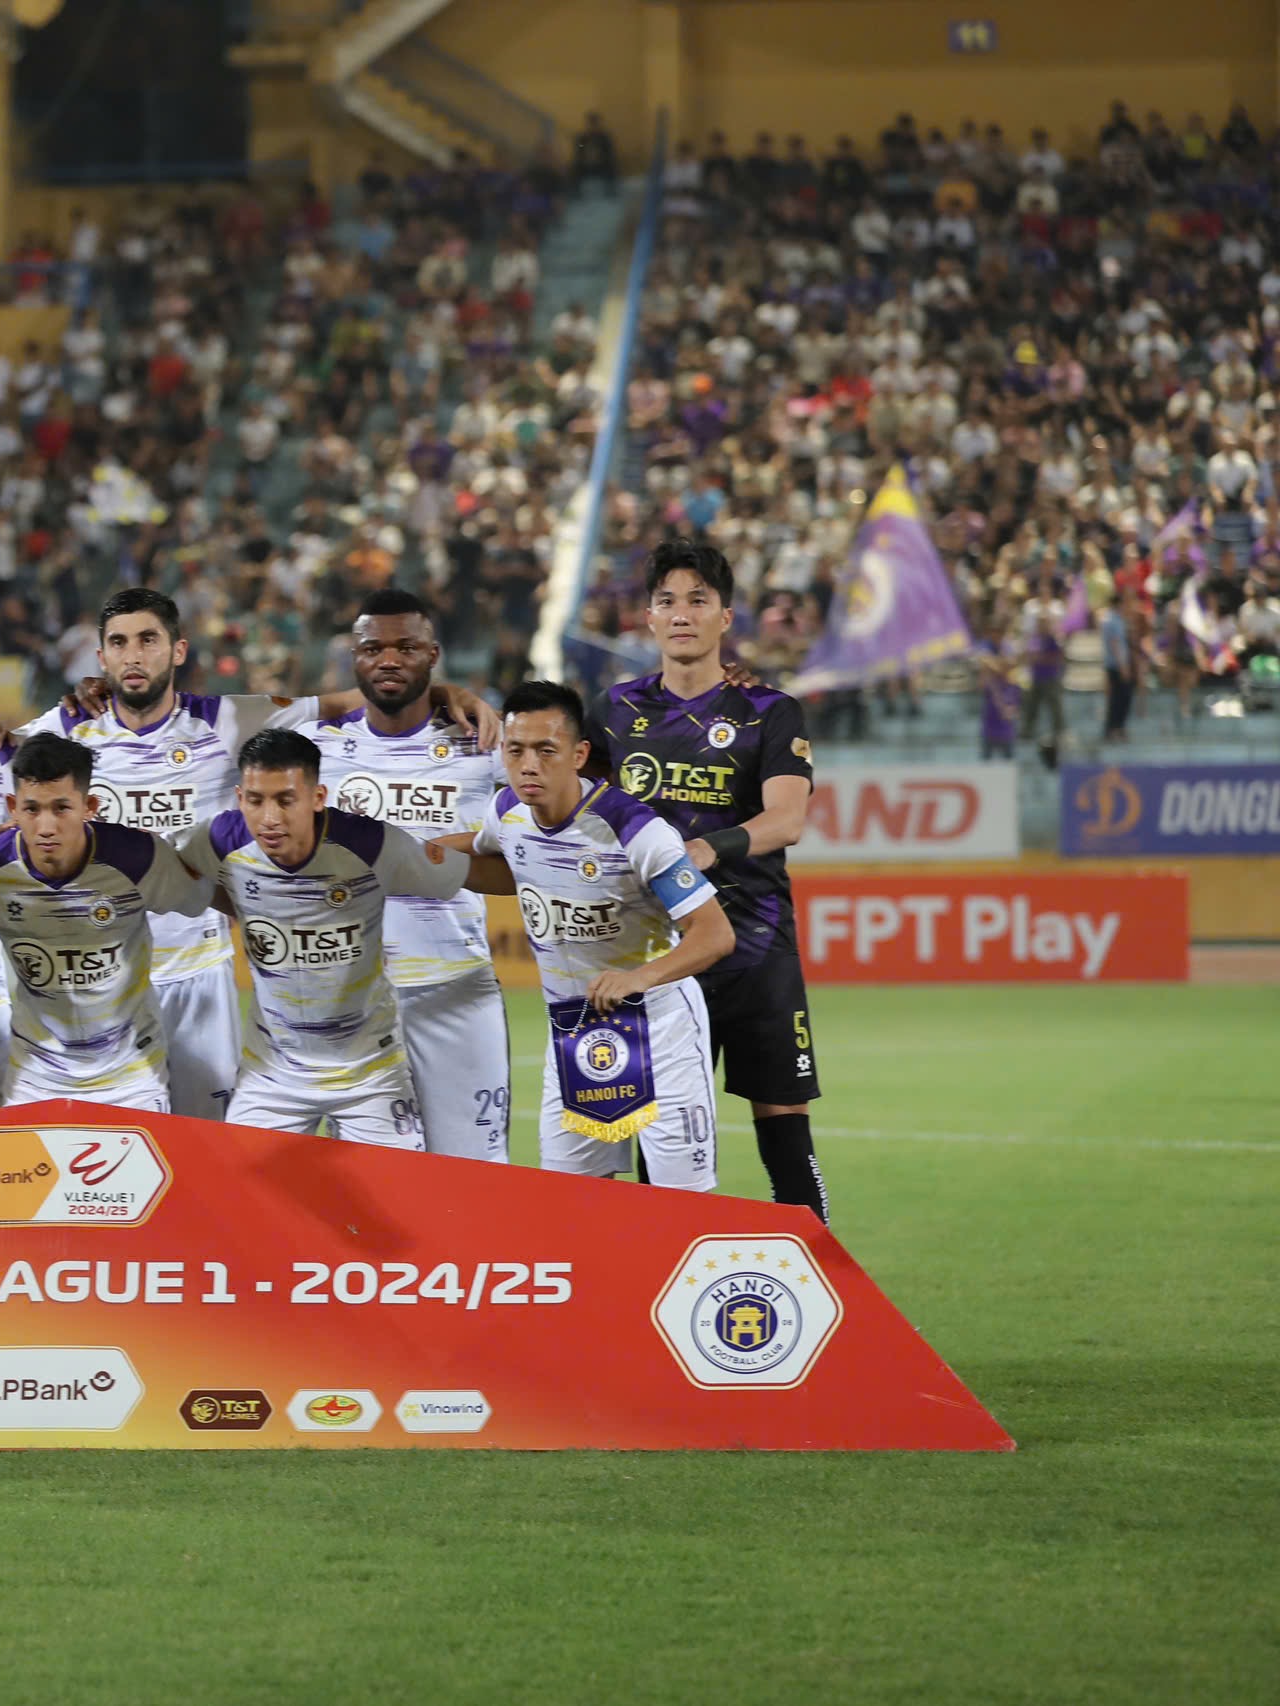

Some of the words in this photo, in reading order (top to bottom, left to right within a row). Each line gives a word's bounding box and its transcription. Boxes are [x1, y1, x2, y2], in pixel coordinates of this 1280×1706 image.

[665, 762, 735, 790] T&T
[126, 788, 194, 813] T&T
[387, 783, 457, 808] T&T
[661, 787, 733, 805] HOMES
[126, 813, 194, 828] HOMES
[386, 808, 455, 824] HOMES
[551, 899, 616, 925] T&T
[291, 923, 361, 951] T&T
[554, 922, 621, 938] HOMES
[807, 895, 950, 963] FPT
[962, 895, 1120, 979] Play
[56, 943, 123, 971] T&T
[293, 946, 362, 965] HOMES
[794, 1010, 810, 1049] 5
[576, 1086, 617, 1103] HANOI
[619, 1084, 636, 1098] FC
[677, 1105, 708, 1145] 10
[64, 1191, 128, 1203] V.LEAGUE
[130, 1192, 135, 1203] 1
[68, 1205, 128, 1216] 2024/25
[201, 1262, 237, 1303] 1
[291, 1261, 573, 1310] 2024/25
[711, 1279, 784, 1303] HANOI
[709, 1344, 758, 1365] FOOTBALL
[761, 1343, 784, 1361] CLUB
[221, 1400, 261, 1413] T&T
[221, 1412, 261, 1420] HOMES
[421, 1402, 484, 1414] Vinawind
